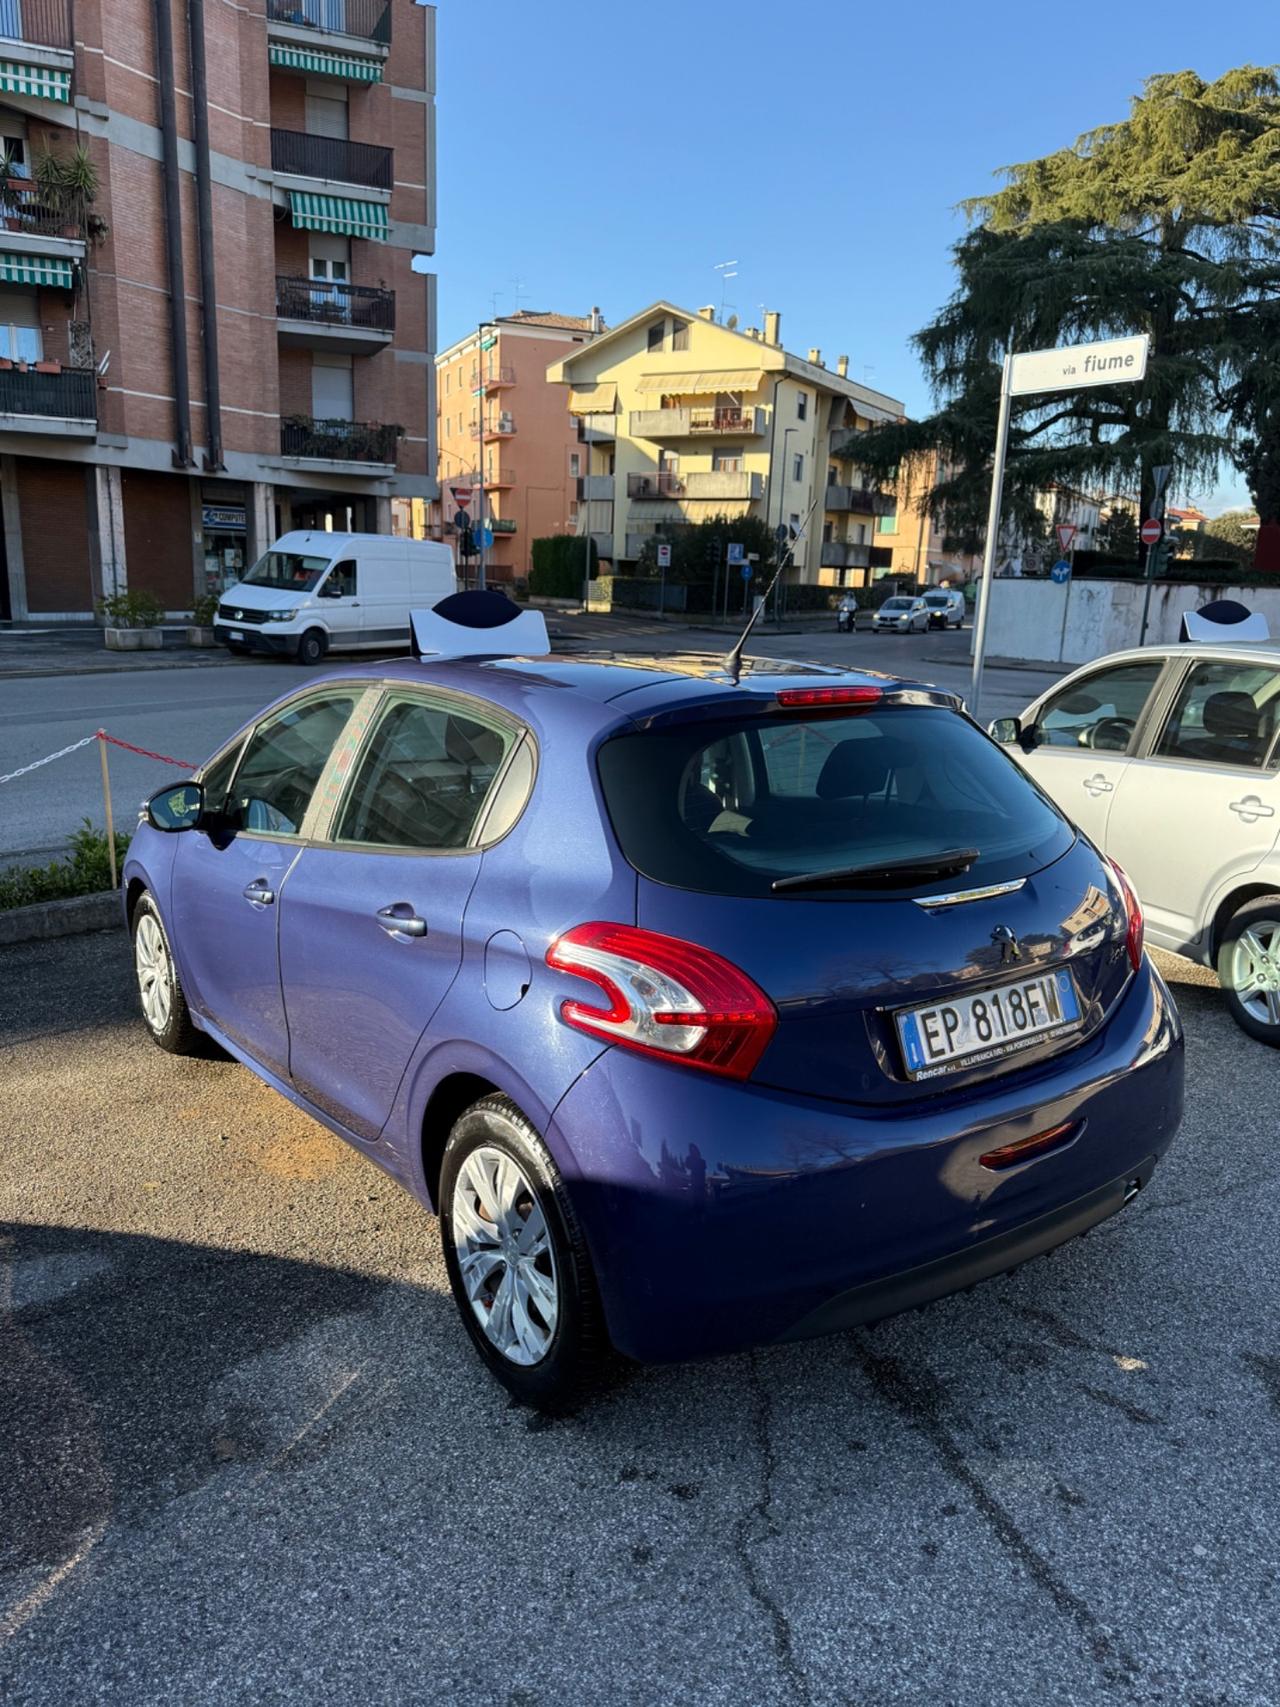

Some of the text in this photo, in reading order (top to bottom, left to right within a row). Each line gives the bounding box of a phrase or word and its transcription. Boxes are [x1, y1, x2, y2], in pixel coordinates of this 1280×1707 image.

[1062, 354, 1135, 375] via fiume
[920, 1007, 960, 1059] EP
[916, 1065, 948, 1081] Rencar
[960, 1051, 994, 1066] VILLAFRANCA
